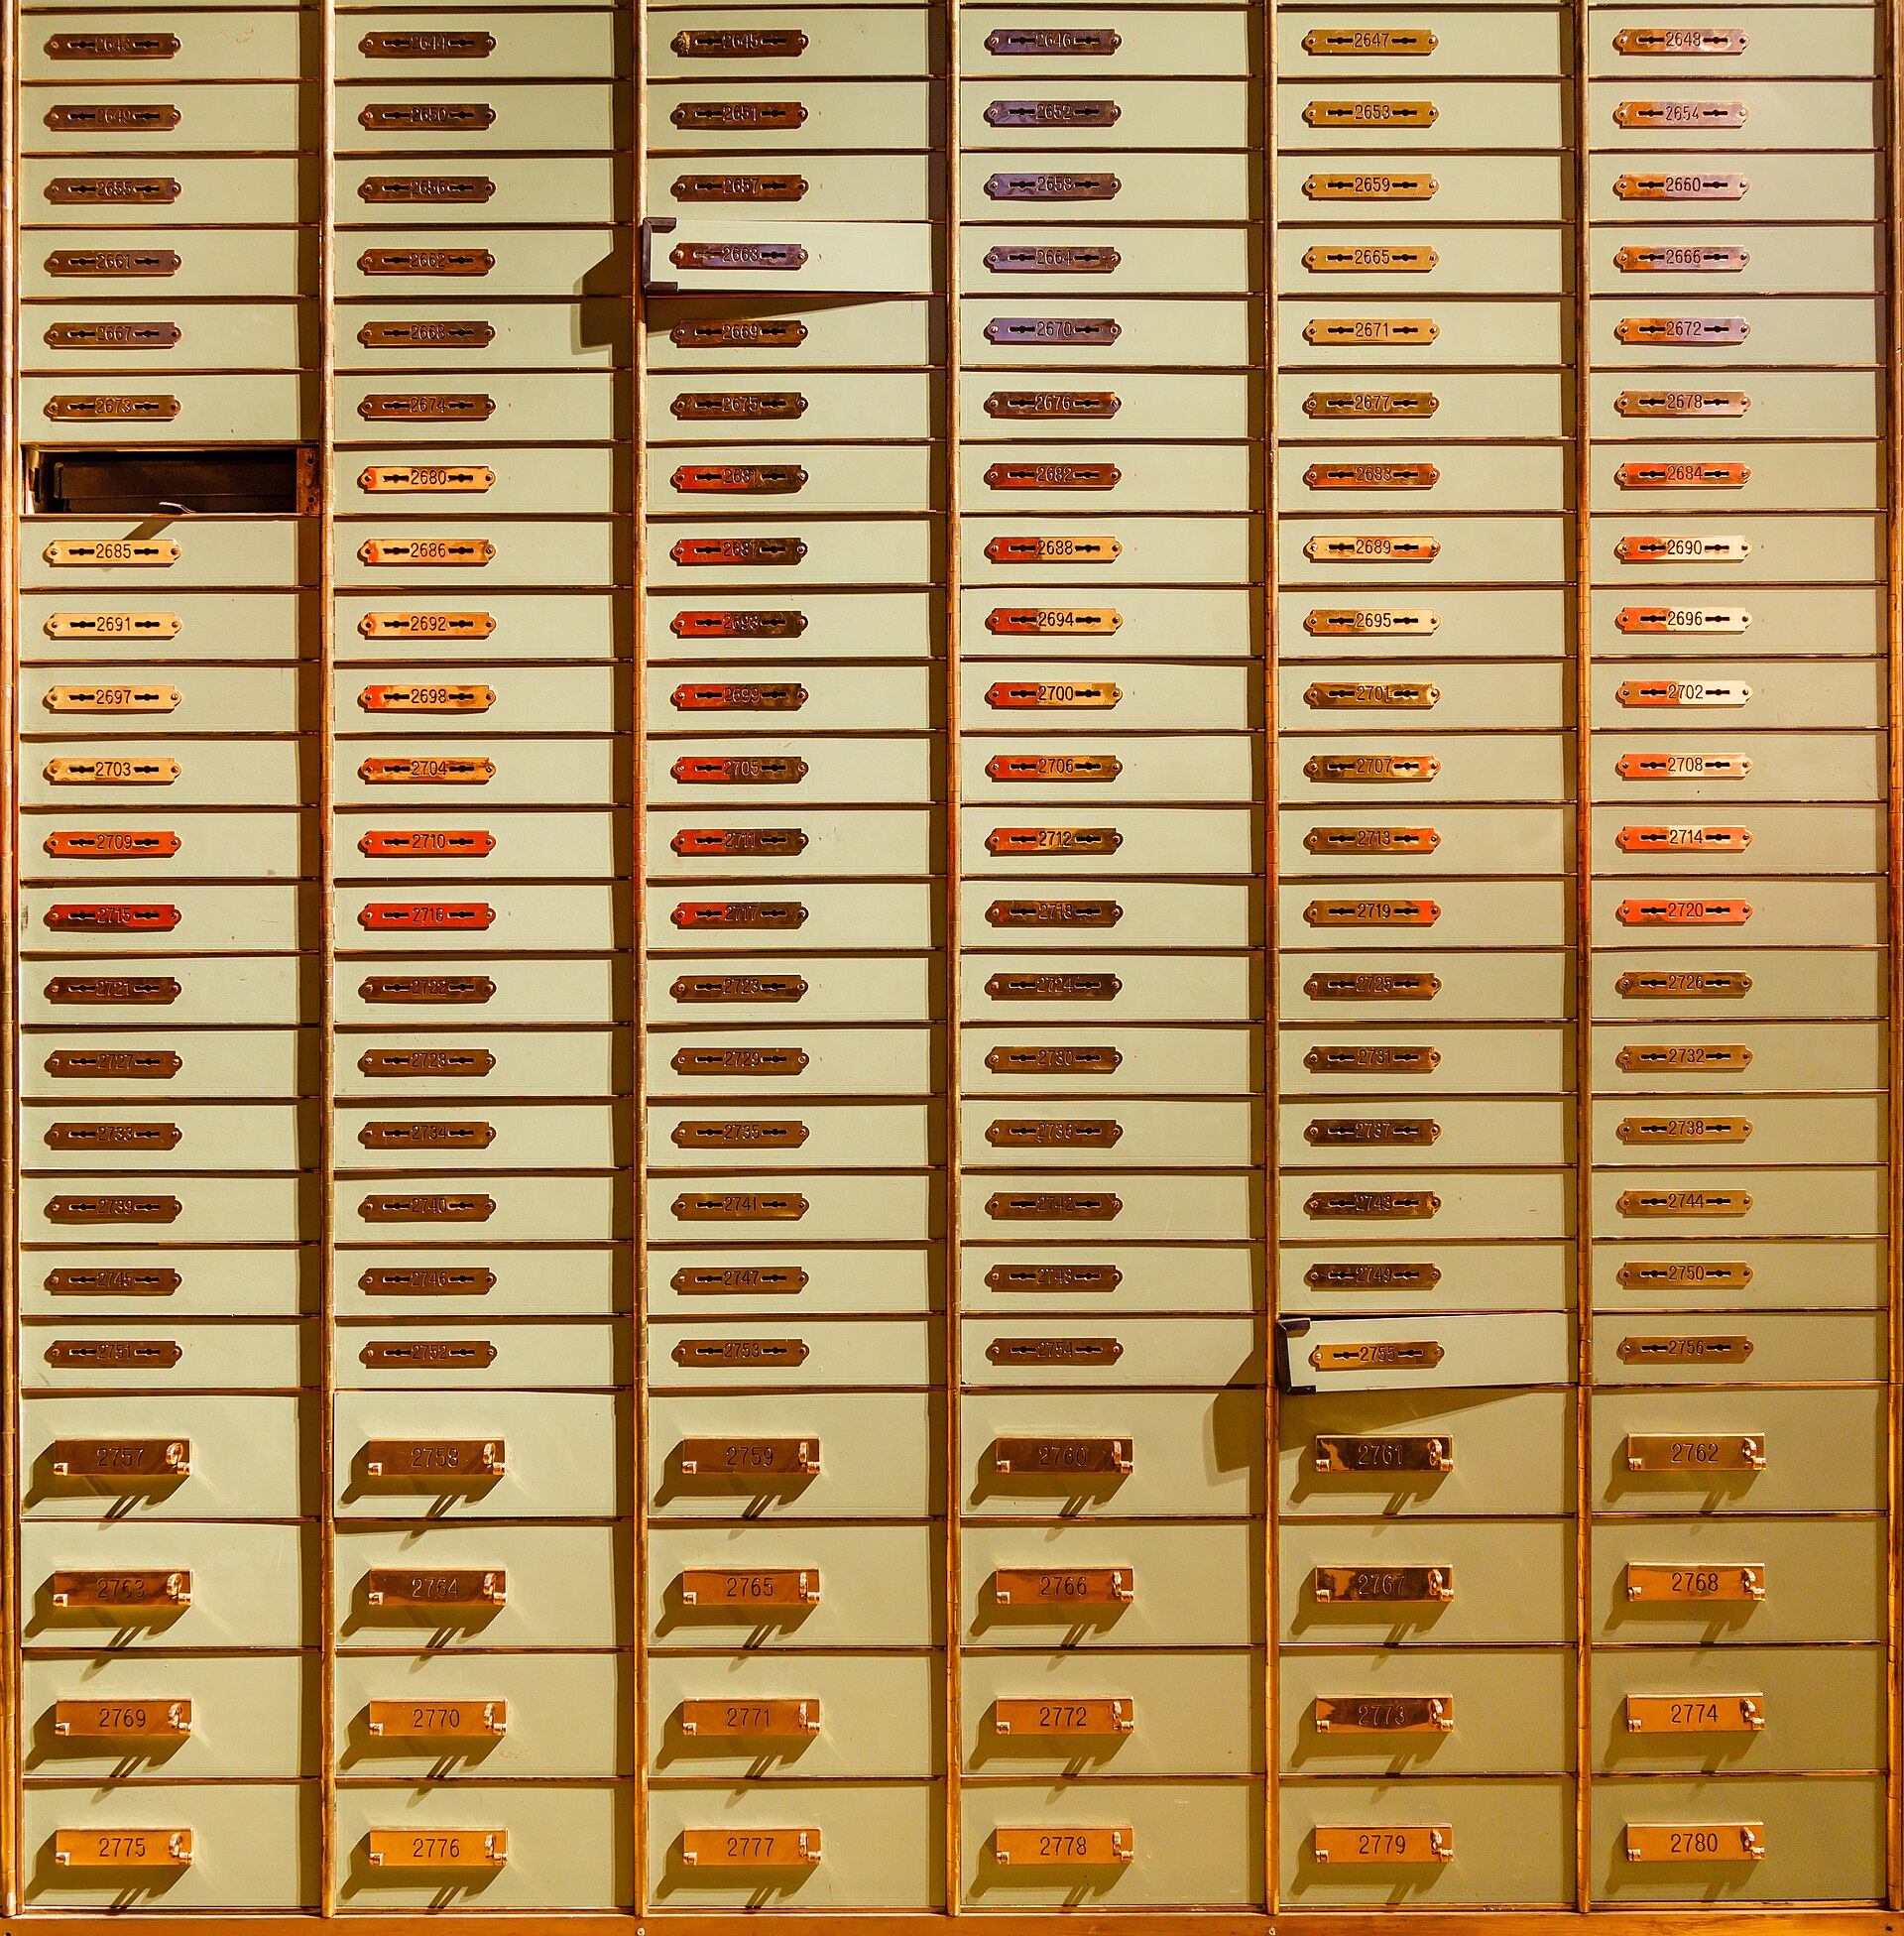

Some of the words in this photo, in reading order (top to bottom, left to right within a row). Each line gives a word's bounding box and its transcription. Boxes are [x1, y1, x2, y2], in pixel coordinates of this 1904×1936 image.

[722, 34, 759, 50] 2645
[1035, 32, 1071, 48] 2646
[1353, 33, 1389, 48] 2647
[1665, 31, 1701, 47] 2648
[411, 107, 447, 123] 2650
[722, 105, 758, 122] 2651
[1035, 103, 1072, 120] 2652
[1355, 104, 1390, 120] 2653
[1665, 105, 1700, 121] 2654
[95, 181, 132, 196] 2655
[411, 180, 446, 195] 2656
[723, 178, 760, 193] 2657
[1037, 176, 1073, 192] 2658
[1355, 177, 1390, 192] 2659
[1666, 177, 1702, 192] 2660
[95, 253, 130, 270] 2661
[410, 252, 446, 268] 2662
[722, 247, 759, 263] 2663
[1036, 249, 1073, 265] 2664
[1354, 249, 1390, 265] 2665
[1666, 249, 1701, 265] 2666
[96, 325, 132, 341] 2667
[411, 324, 445, 340] 2668
[722, 323, 759, 340] 2669
[1035, 320, 1072, 337] 2670
[1355, 322, 1389, 337] 2671
[1666, 321, 1702, 337] 2672
[95, 399, 132, 415] 2673
[410, 397, 446, 413] 2674
[722, 396, 759, 413] 2675
[1034, 395, 1071, 411] 2676
[1354, 395, 1390, 411] 2677
[1666, 394, 1703, 410] 2678
[411, 470, 446, 485] 2680
[1036, 466, 1073, 483] 2682
[1355, 466, 1391, 482] 2683
[1667, 465, 1703, 481] 2684
[95, 544, 131, 558] 2685
[411, 543, 446, 558] 2686
[722, 542, 759, 557] 2687
[1036, 540, 1073, 555] 2688
[1356, 540, 1391, 554] 2689
[1667, 540, 1703, 554] 2690
[96, 617, 131, 632] 2691
[411, 616, 446, 631] 2692
[723, 615, 760, 630] 2693
[1037, 611, 1074, 627] 2694
[1356, 612, 1391, 628] 2695
[1667, 611, 1703, 626] 2696
[95, 689, 132, 705] 2697
[411, 688, 446, 704] 2698
[723, 687, 760, 703] 2699
[1038, 686, 1074, 701] 2700
[1356, 685, 1390, 701] 2701
[1668, 684, 1704, 699] 2702
[95, 762, 131, 777] 2703
[411, 761, 447, 776] 2704
[723, 760, 760, 776] 2705
[1037, 758, 1074, 774] 2706
[1356, 758, 1392, 774] 2707
[1667, 757, 1703, 772] 2708
[96, 835, 132, 850] 2709
[412, 833, 445, 849] 2710
[724, 832, 757, 848] 2711
[1037, 830, 1072, 847] 2712
[1357, 830, 1391, 846] 2713
[1669, 829, 1704, 845] 2714
[97, 908, 132, 923] 2715
[412, 908, 444, 922] 2716
[724, 906, 758, 921] 2717
[1357, 904, 1391, 919] 2719
[1668, 903, 1704, 918] 2720
[95, 980, 130, 996] 2721
[411, 980, 447, 995] 2722
[723, 978, 760, 995] 2723
[1036, 977, 1074, 993] 2724
[1356, 976, 1392, 992] 2725
[1668, 975, 1704, 991] 2726
[97, 1053, 134, 1069] 2727
[411, 1052, 447, 1068] 2728
[723, 1051, 760, 1066] 2729
[1037, 1049, 1074, 1066] 2730
[1357, 1049, 1391, 1065] 2731
[1668, 1048, 1705, 1064] 2732
[96, 1126, 133, 1142] 2733
[410, 1125, 447, 1141] 2734
[724, 1124, 760, 1141] 2735
[1036, 1124, 1073, 1139] 2736
[1356, 1122, 1390, 1139] 2737
[1668, 1120, 1704, 1136] 2738
[96, 1200, 133, 1215] 2739
[411, 1198, 447, 1213] 2740
[723, 1196, 757, 1212] 2741
[1356, 1194, 1392, 1211] 2743
[1668, 1193, 1705, 1209] 2744
[96, 1271, 132, 1287] 2745
[411, 1271, 446, 1286] 2746
[723, 1270, 760, 1286] 2747
[1036, 1269, 1073, 1284] 2748
[1356, 1268, 1392, 1283] 2749
[1668, 1266, 1704, 1281] 2750
[96, 1345, 131, 1360] 2751
[412, 1344, 447, 1360] 2752
[724, 1343, 760, 1359] 2753
[1037, 1342, 1073, 1358] 2754
[1360, 1346, 1395, 1362] 2755
[1668, 1340, 1704, 1356] 2756
[97, 1448, 144, 1467] 2757
[412, 1448, 459, 1468] 2758
[726, 1446, 774, 1467] 2759
[1039, 1447, 1087, 1467] 2760
[1359, 1444, 1403, 1465] 2761
[1671, 1443, 1719, 1463] 2762
[97, 1577, 145, 1599] 2763
[412, 1578, 459, 1598] 2764
[726, 1577, 774, 1597] 2765
[1039, 1577, 1087, 1596] 2766
[1359, 1574, 1405, 1595] 2767
[1672, 1573, 1719, 1592] 2768
[99, 1708, 146, 1728] 2769
[413, 1709, 460, 1728] 2770
[727, 1708, 770, 1728] 2771
[1039, 1707, 1087, 1727] 2772
[1359, 1705, 1405, 1725] 2773
[1671, 1704, 1719, 1724] 2774
[99, 1838, 145, 1857] 2775
[413, 1838, 460, 1858] 2776
[727, 1838, 774, 1857] 2777
[1040, 1837, 1087, 1856] 2778
[1359, 1835, 1406, 1855] 2779
[1671, 1833, 1719, 1853] 2780
